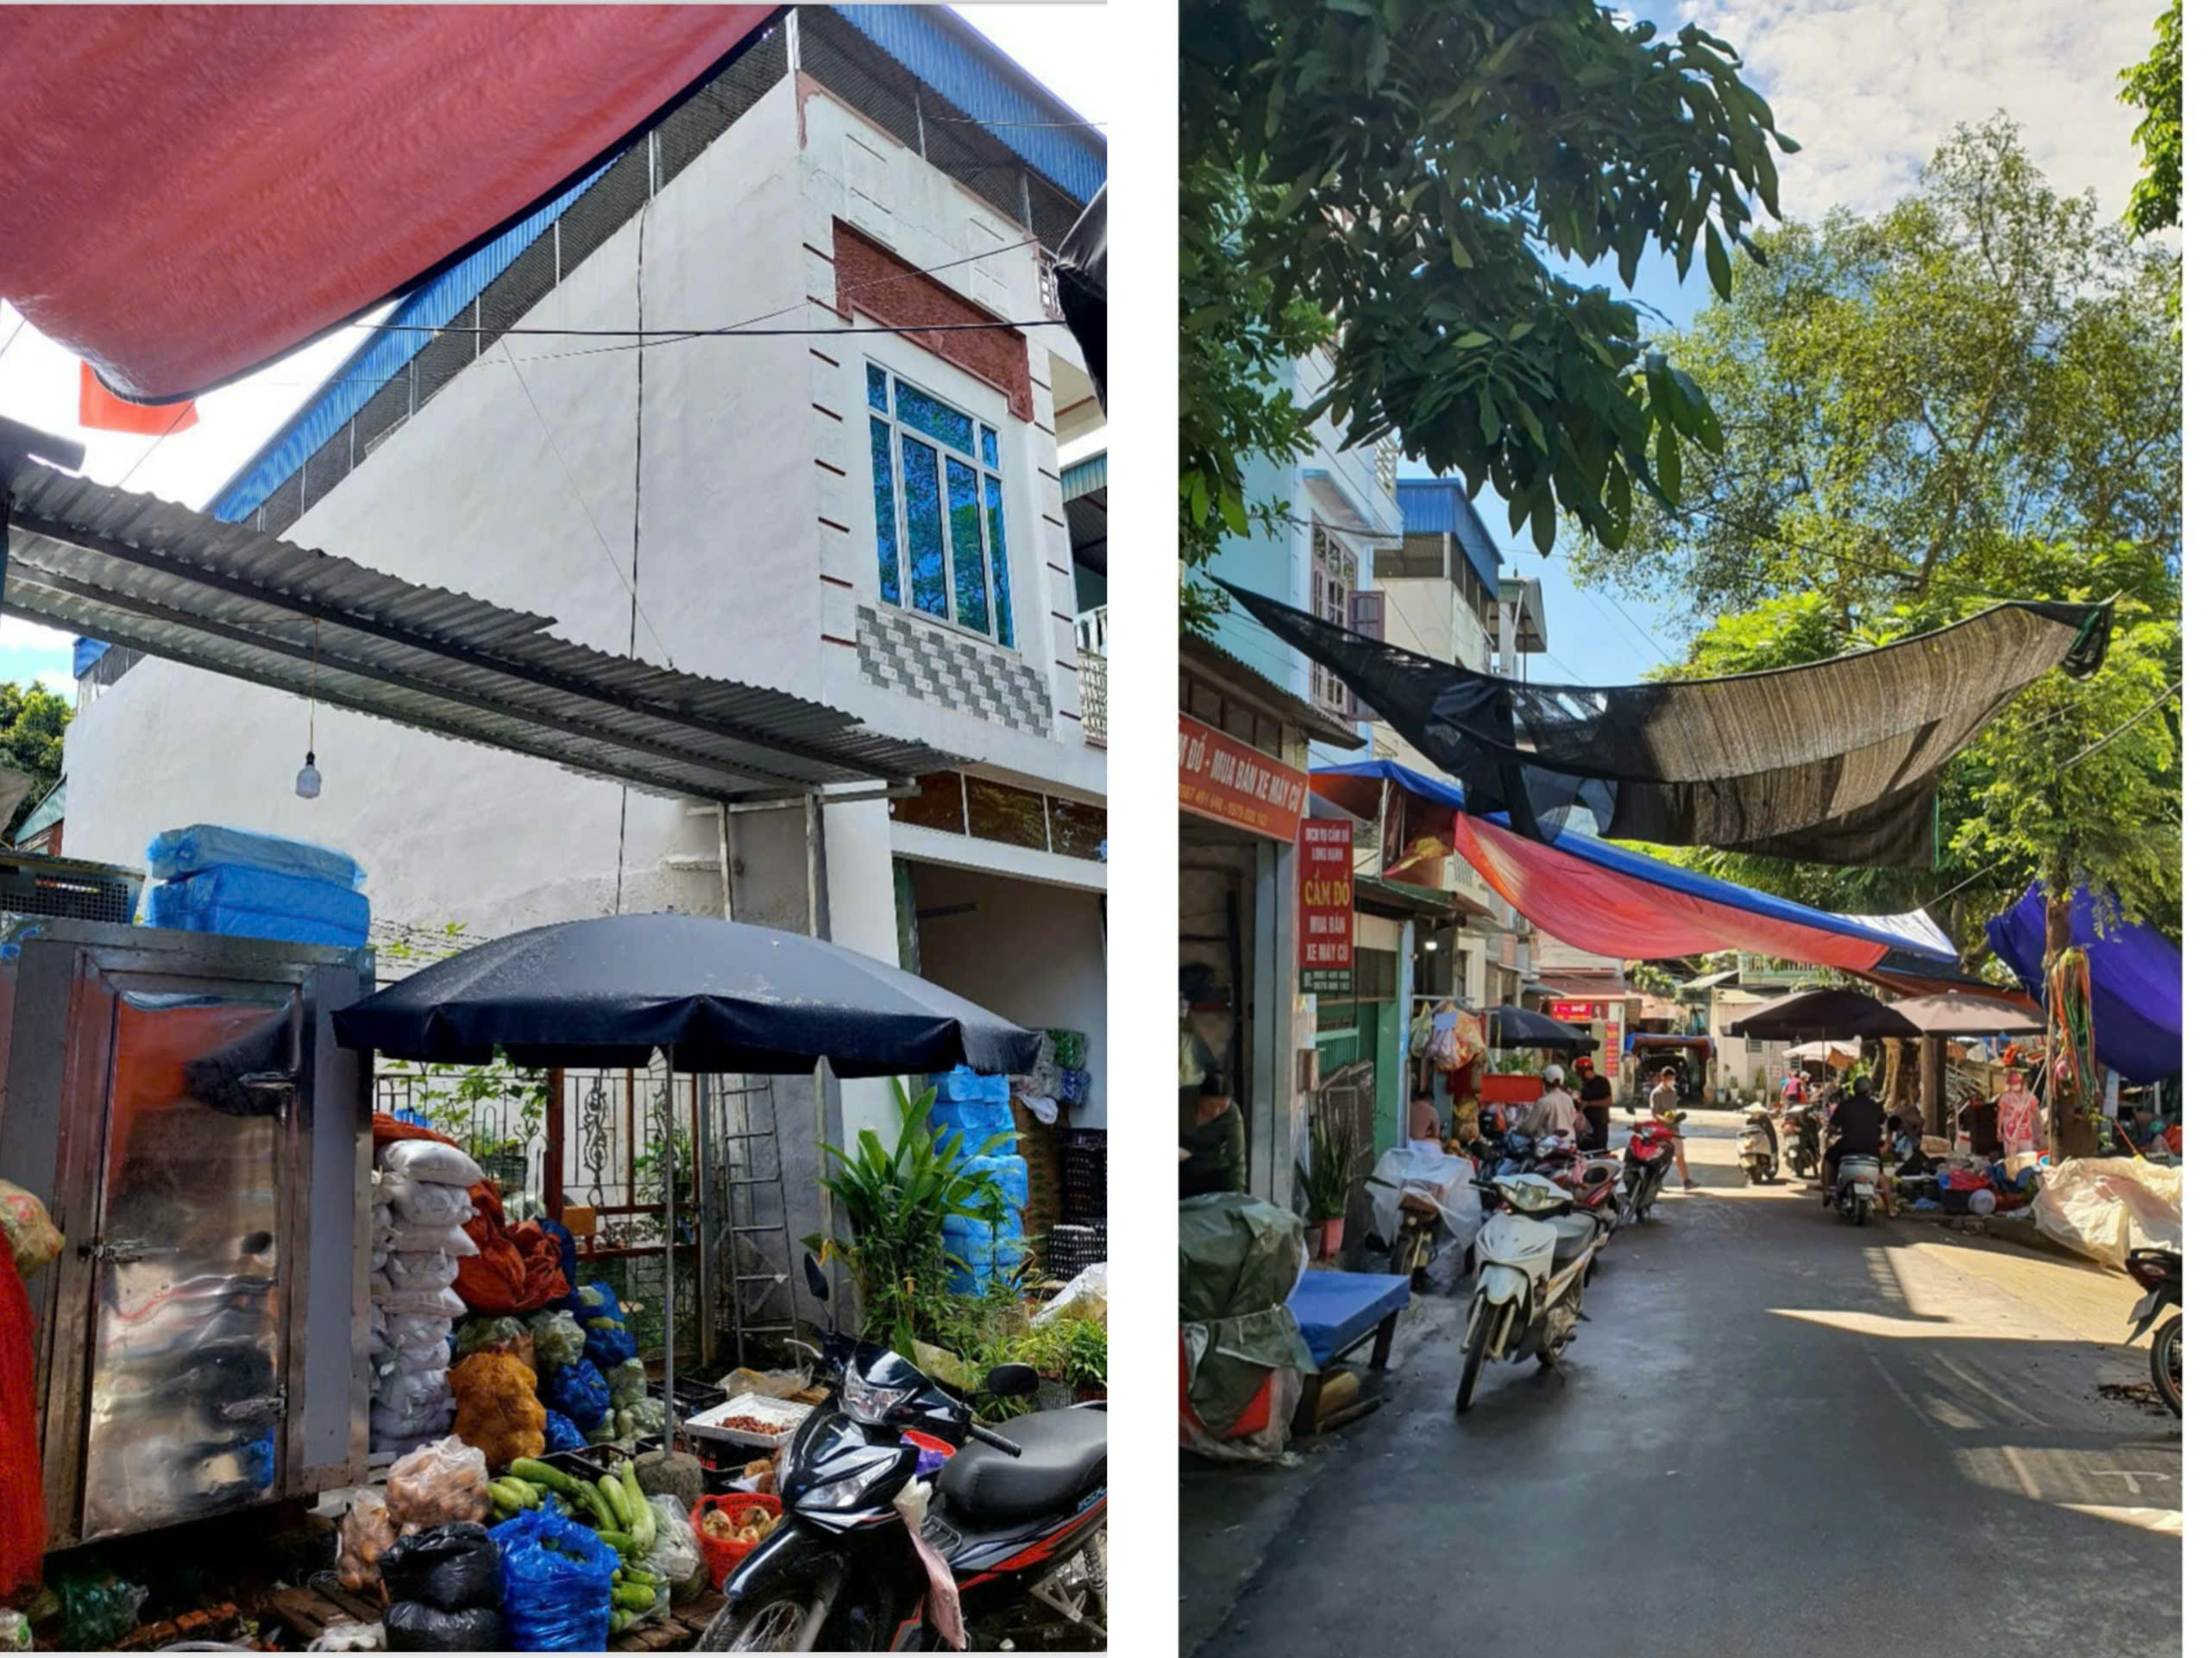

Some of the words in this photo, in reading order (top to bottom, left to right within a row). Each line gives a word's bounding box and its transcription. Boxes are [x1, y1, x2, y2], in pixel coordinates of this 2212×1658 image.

[1210, 749, 1236, 788] MUA
[1235, 757, 1259, 794] BÁN
[1254, 768, 1271, 801] XE
[1268, 774, 1291, 808] MÁY
[1310, 915, 1327, 934] MUA
[1306, 943, 1317, 962] XE
